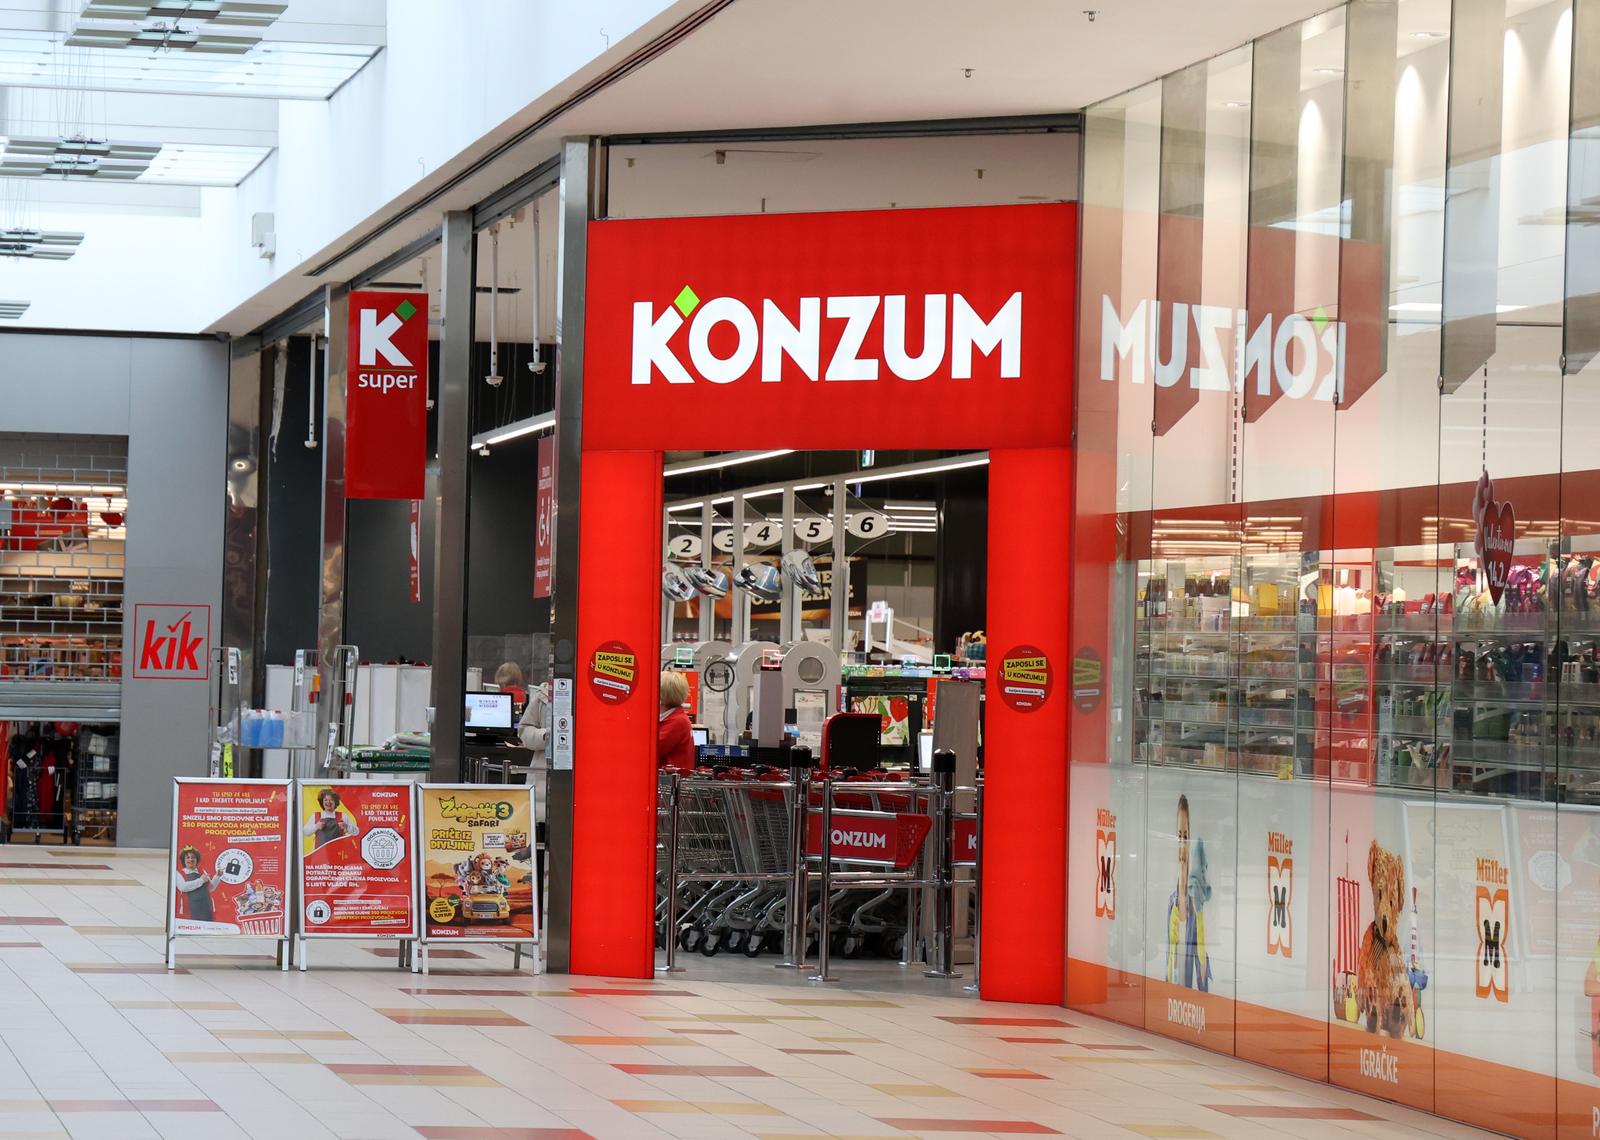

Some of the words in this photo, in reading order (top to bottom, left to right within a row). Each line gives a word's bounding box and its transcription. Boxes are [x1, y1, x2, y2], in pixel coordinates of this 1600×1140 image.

[360, 308, 413, 366] K
[631, 291, 1022, 384] KONZUM
[358, 373, 418, 394] super
[806, 522, 821, 538] 5
[860, 516, 875, 533] 6
[757, 526, 770, 541] 4
[680, 539, 693, 553] 2
[140, 612, 204, 671] kik
[597, 654, 624, 663] ZAPOSLI
[624, 656, 633, 664] SE
[1006, 660, 1034, 669] ZAPOSLI
[1035, 659, 1045, 667] SE
[1012, 672, 1045, 682] KONZUMU!
[498, 803, 510, 817] 3
[1096, 808, 1117, 829] Müller
[468, 820, 500, 828] SAFARI
[432, 828, 461, 840] PRIČE
[462, 831, 473, 840] IZ
[831, 829, 886, 849] ONZUM
[430, 840, 475, 851] DIVLJINE
[1267, 832, 1293, 855] Müller
[1475, 857, 1508, 885] Müller
[1168, 998, 1206, 1033] DROGERIJA
[1360, 1044, 1399, 1084] IGRAČKE
